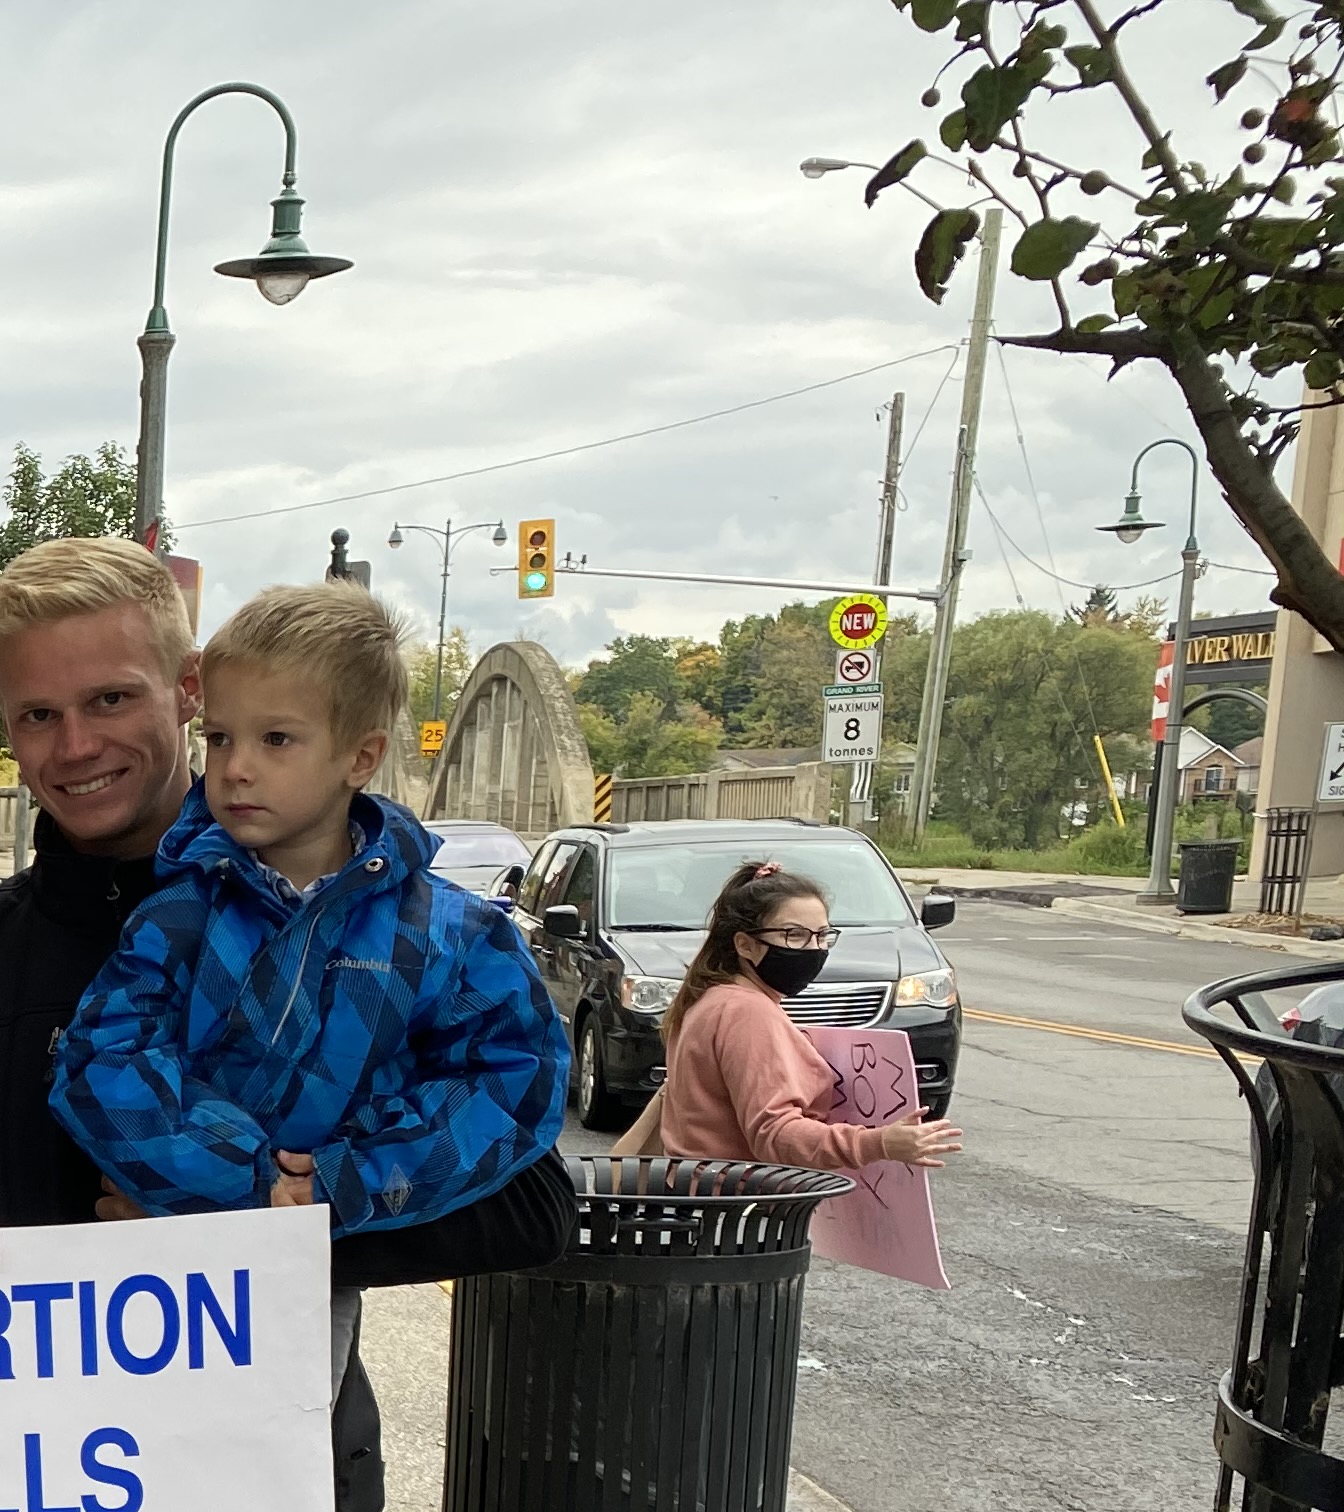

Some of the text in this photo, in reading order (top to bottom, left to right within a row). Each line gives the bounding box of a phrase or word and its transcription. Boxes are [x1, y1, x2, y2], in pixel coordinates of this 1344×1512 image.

[841, 612, 876, 631] NEW
[1186, 636, 1231, 665] IVER
[826, 685, 880, 696] GRAND RIVER
[828, 702, 880, 714] MAXIMUM
[424, 729, 444, 742] 25
[843, 718, 861, 741] 8
[829, 746, 874, 758] tonnes
